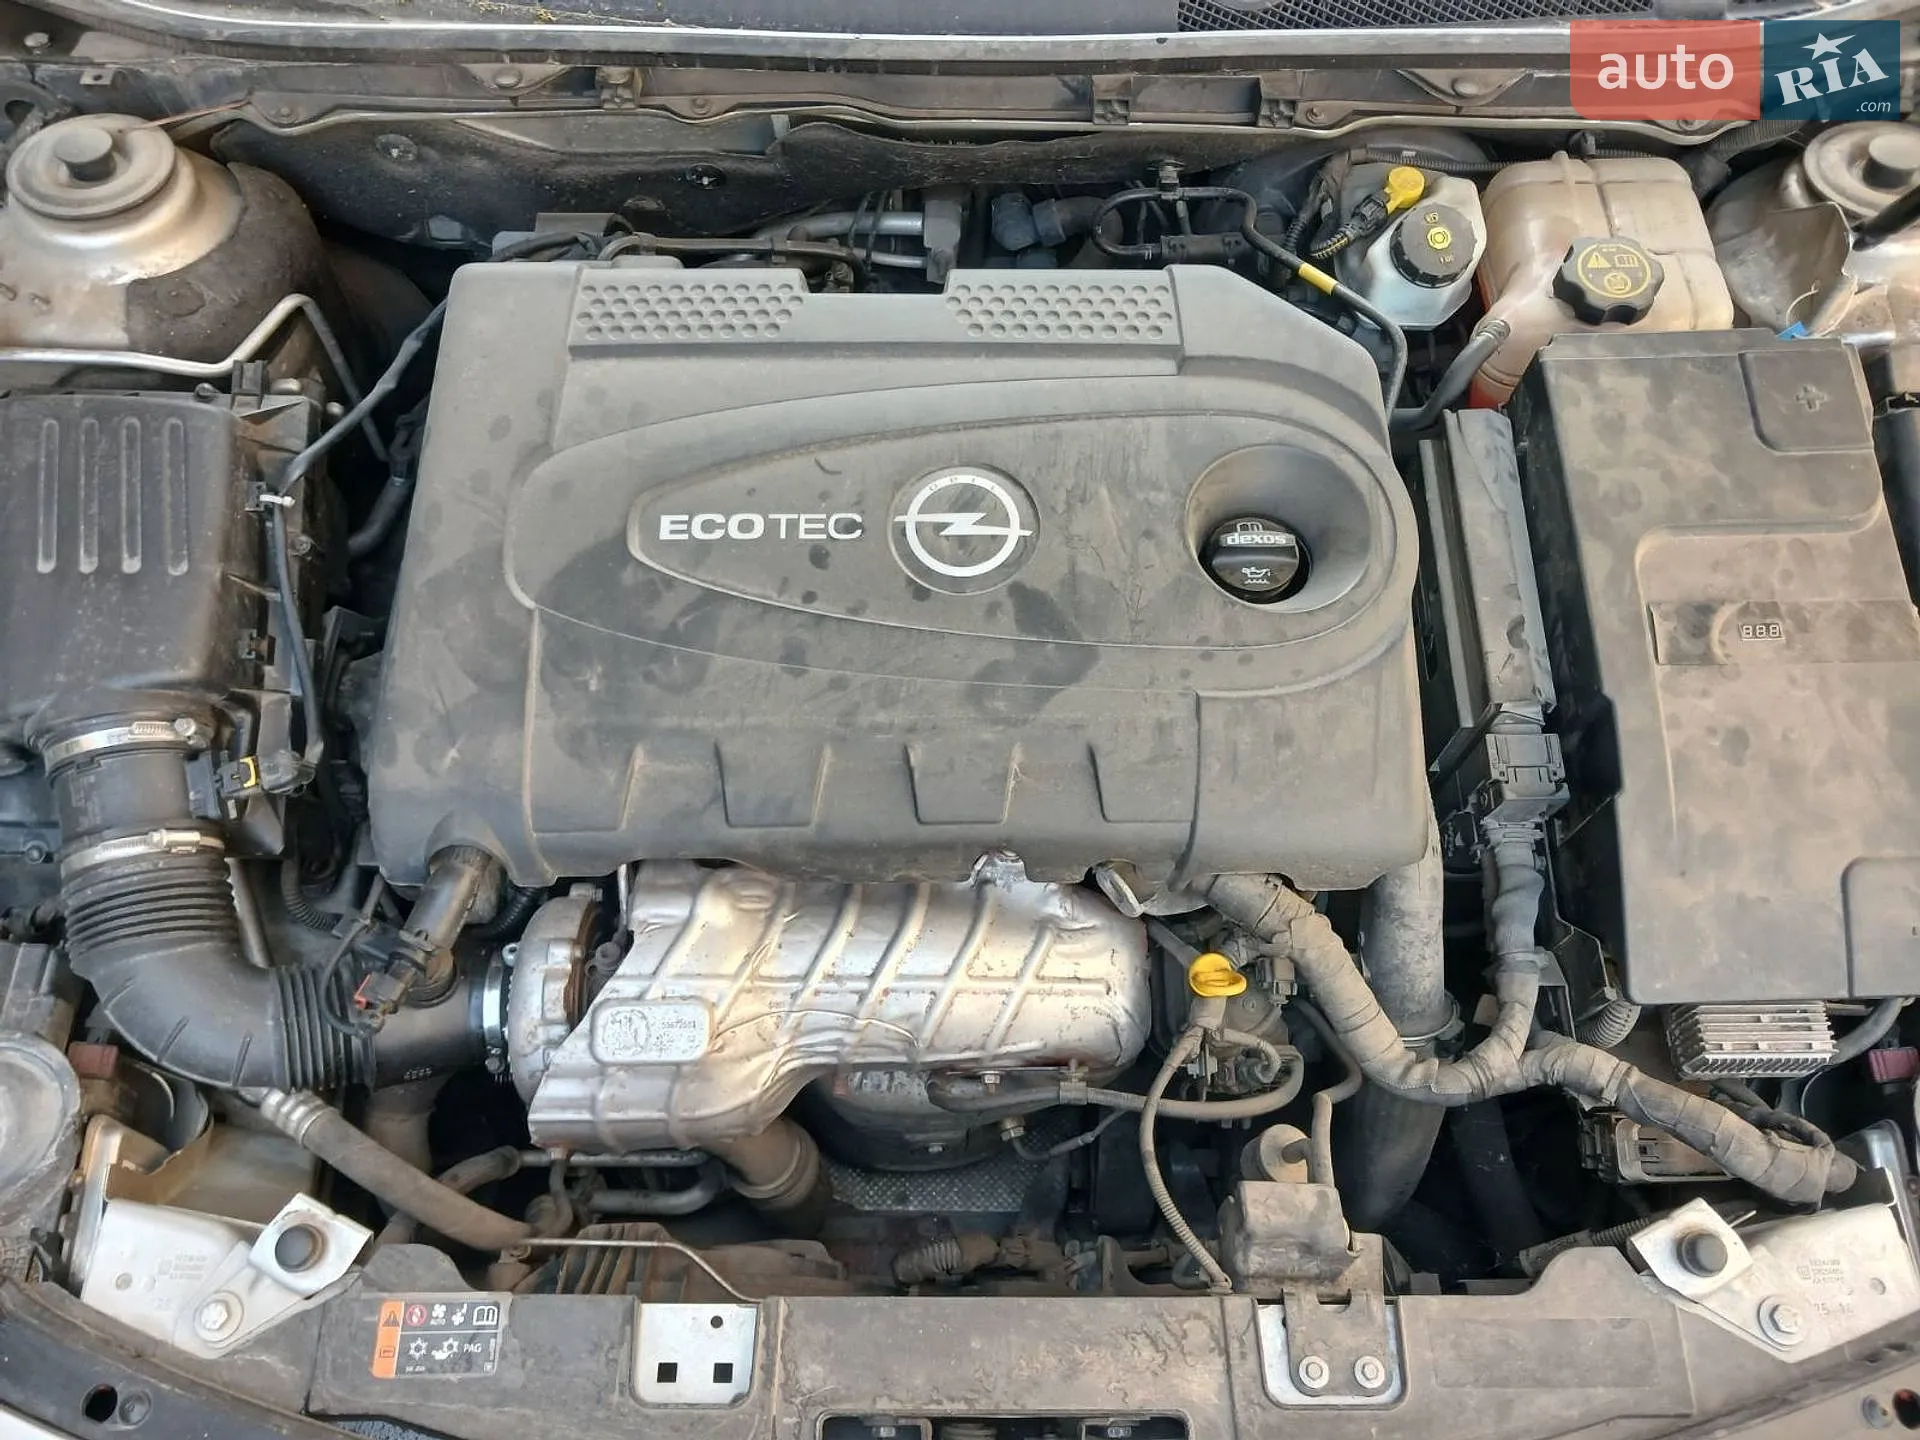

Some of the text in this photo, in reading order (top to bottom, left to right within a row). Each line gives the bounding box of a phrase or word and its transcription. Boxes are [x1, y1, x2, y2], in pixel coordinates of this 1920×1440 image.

[659, 512, 863, 540] ECOTEC
[1226, 531, 1287, 545] dexos
[463, 1343, 482, 1353] PAG
